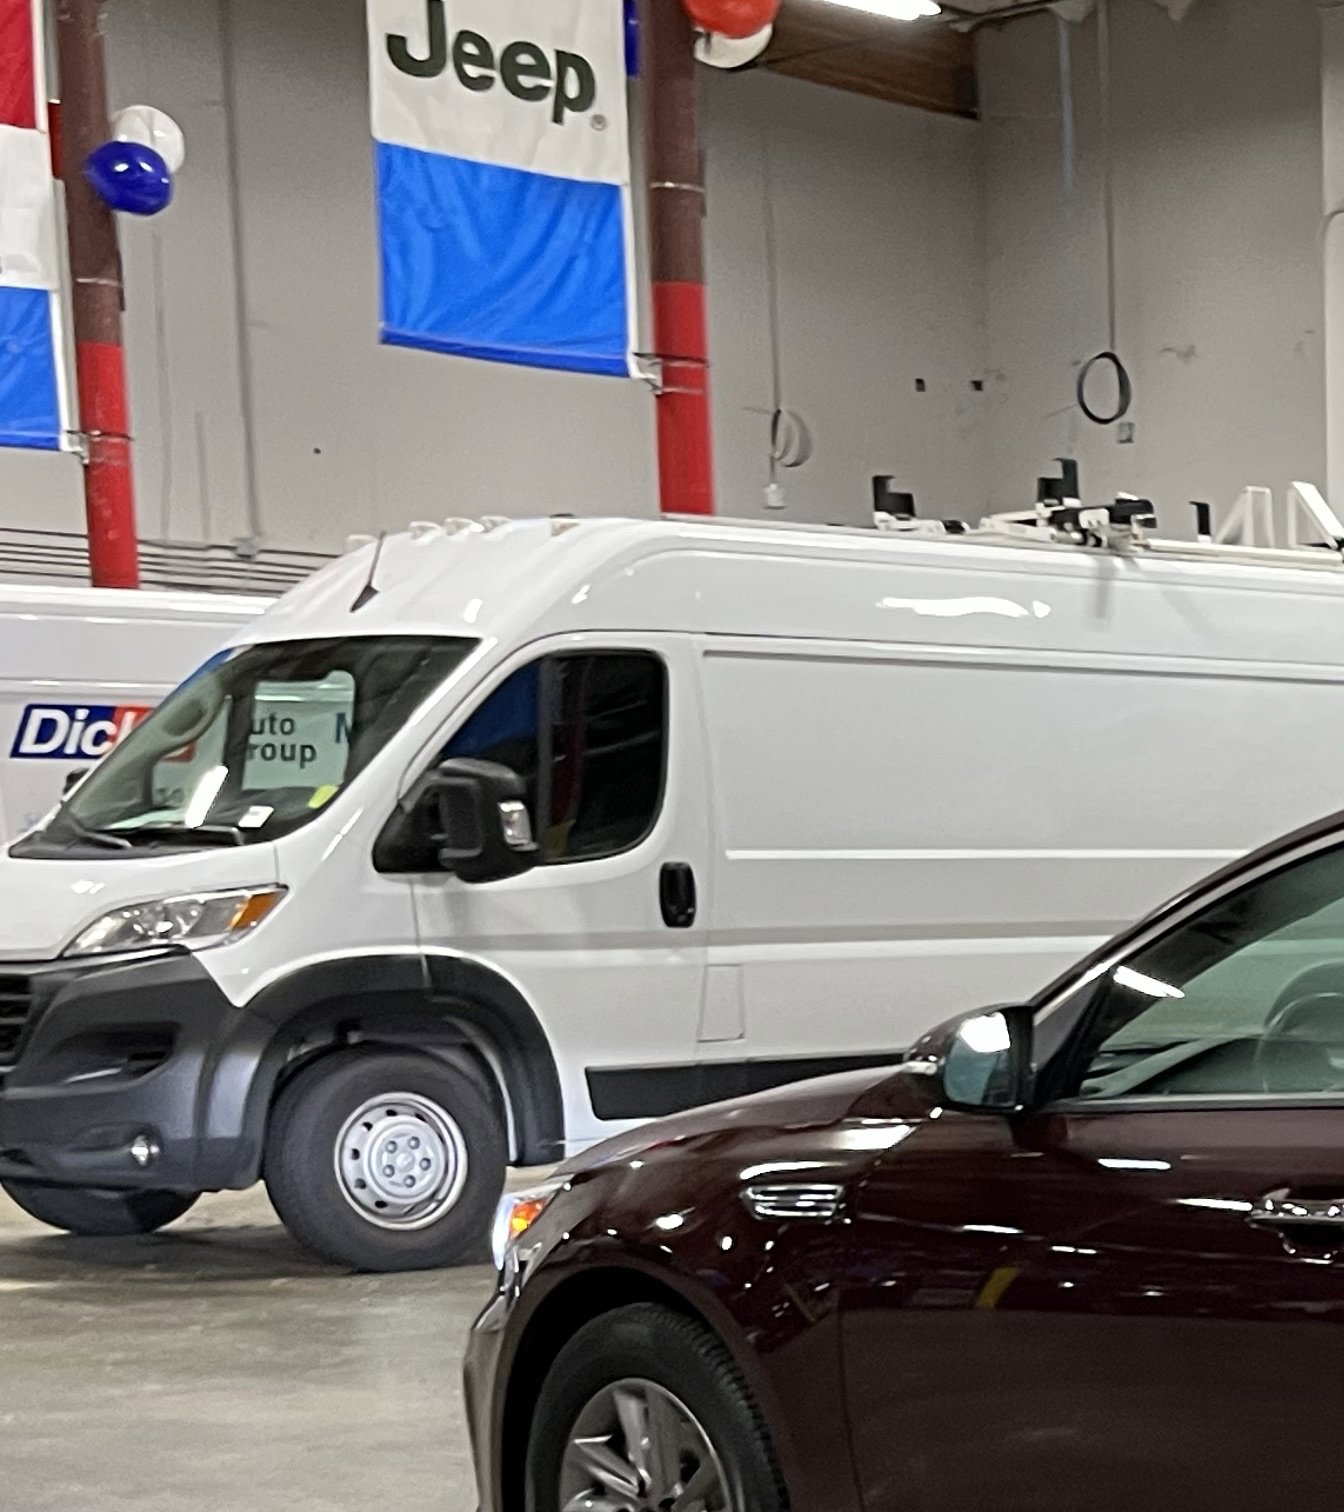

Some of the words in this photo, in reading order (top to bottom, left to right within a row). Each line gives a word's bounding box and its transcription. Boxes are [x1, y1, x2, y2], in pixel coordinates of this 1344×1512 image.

[386, 0, 596, 126] Jeep
[251, 713, 295, 735] uto
[248, 743, 317, 769] roup
